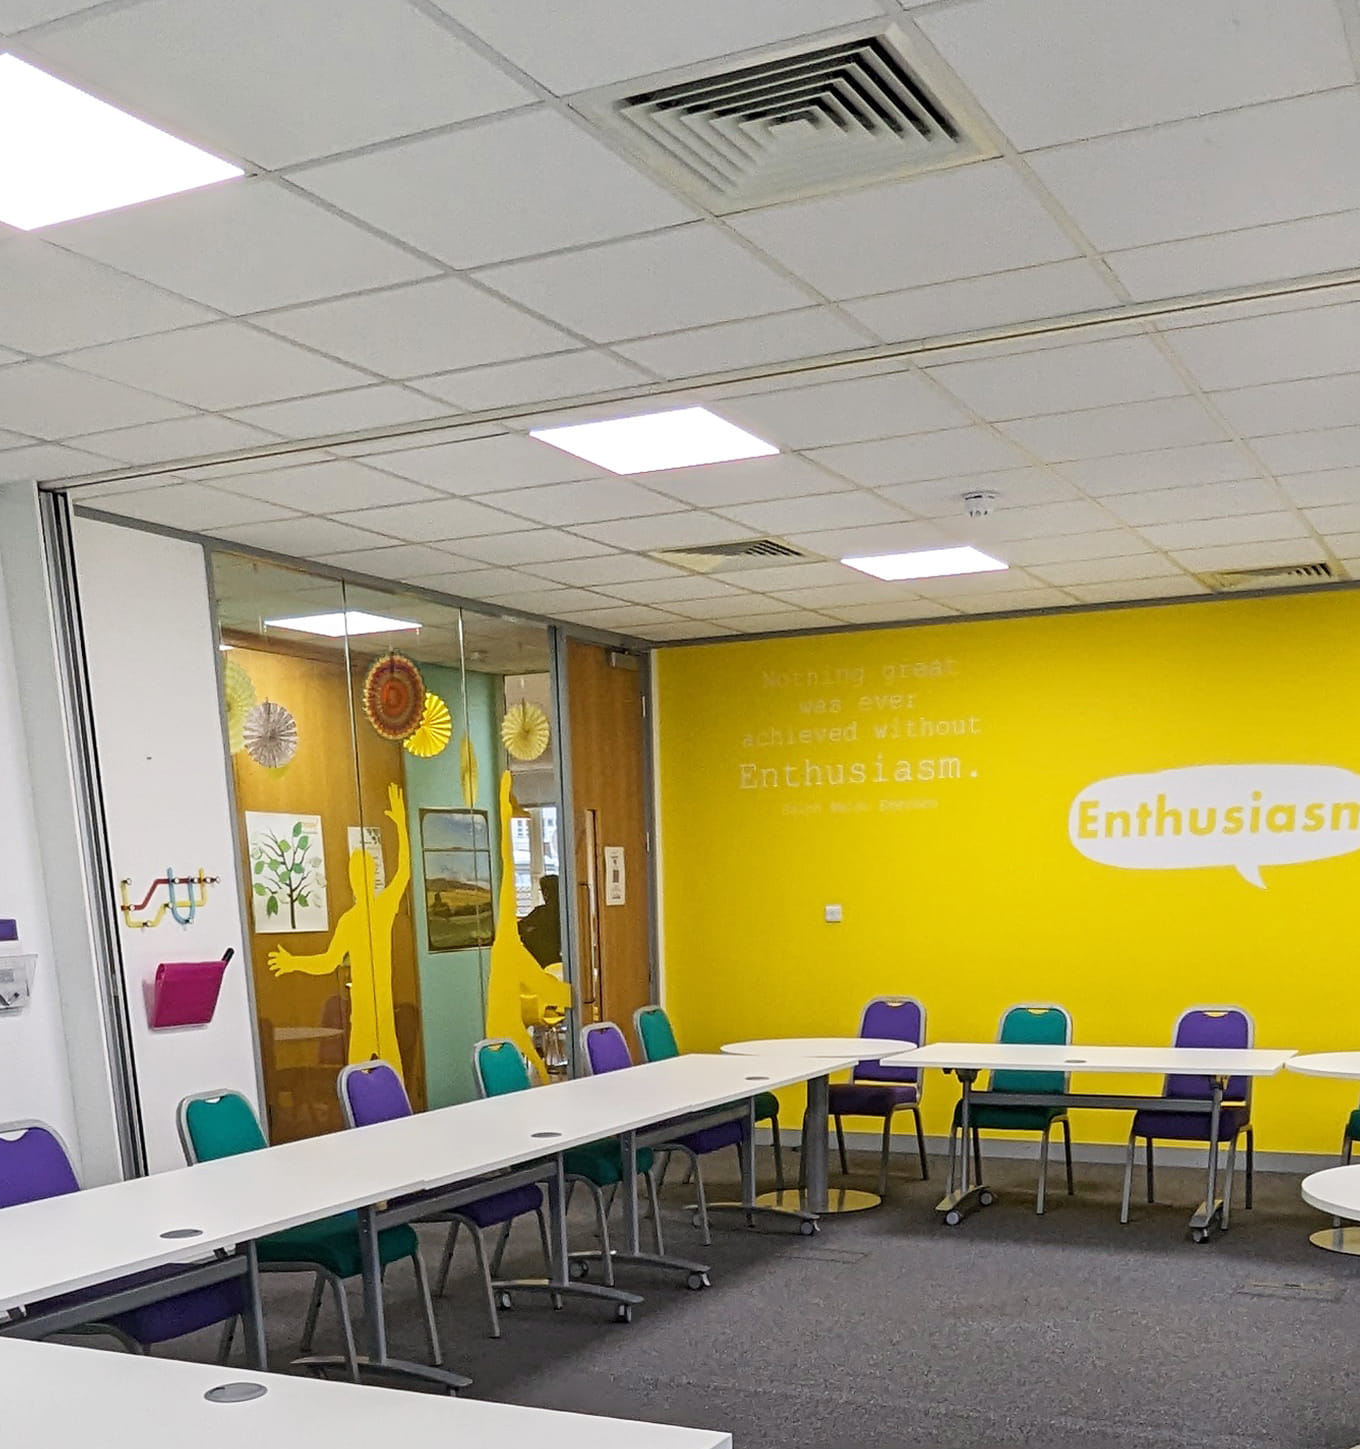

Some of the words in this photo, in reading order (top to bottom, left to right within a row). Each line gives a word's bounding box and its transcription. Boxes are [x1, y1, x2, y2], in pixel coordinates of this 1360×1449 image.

[761, 666, 865, 689] Nothing
[882, 658, 959, 684] great
[799, 699, 842, 714] was
[857, 693, 918, 711] ever
[742, 721, 859, 748] achieved
[872, 714, 982, 740] without
[738, 754, 980, 790] Enthusiasm.
